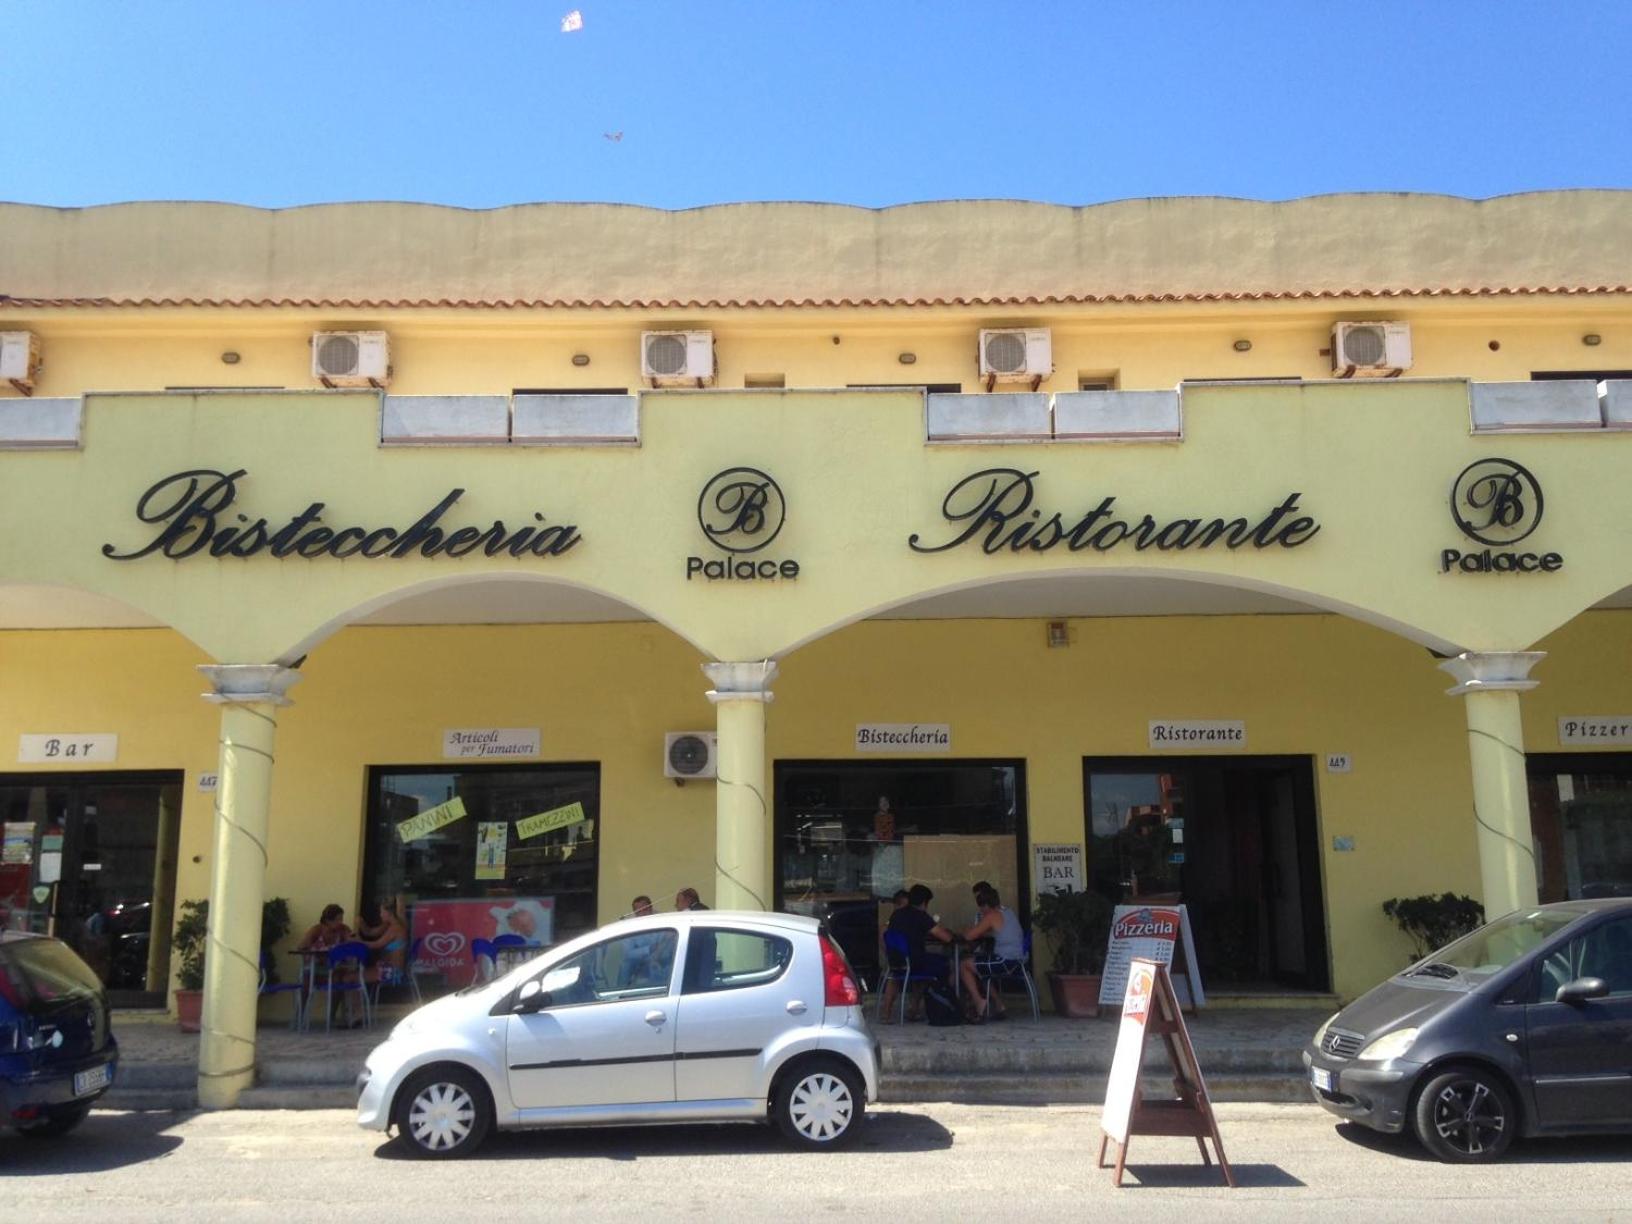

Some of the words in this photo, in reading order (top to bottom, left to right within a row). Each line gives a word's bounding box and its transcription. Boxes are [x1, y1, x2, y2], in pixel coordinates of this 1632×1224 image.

[103, 469, 582, 561] Bisteccheria
[908, 468, 1320, 554] Ristorante
[687, 556, 800, 580] Palace
[1441, 549, 1563, 573] Palace
[449, 730, 499, 744] Articoli
[857, 725, 950, 745] Bisteccheria
[1153, 724, 1243, 742] Ristorante
[1564, 721, 1632, 737] Pizzer
[45, 738, 95, 757] Bar
[460, 745, 476, 756] per
[478, 742, 535, 756] Fumatori
[400, 807, 455, 838] PANINI
[1043, 866, 1075, 879] BAR
[1114, 920, 1173, 937] Pizzeria
